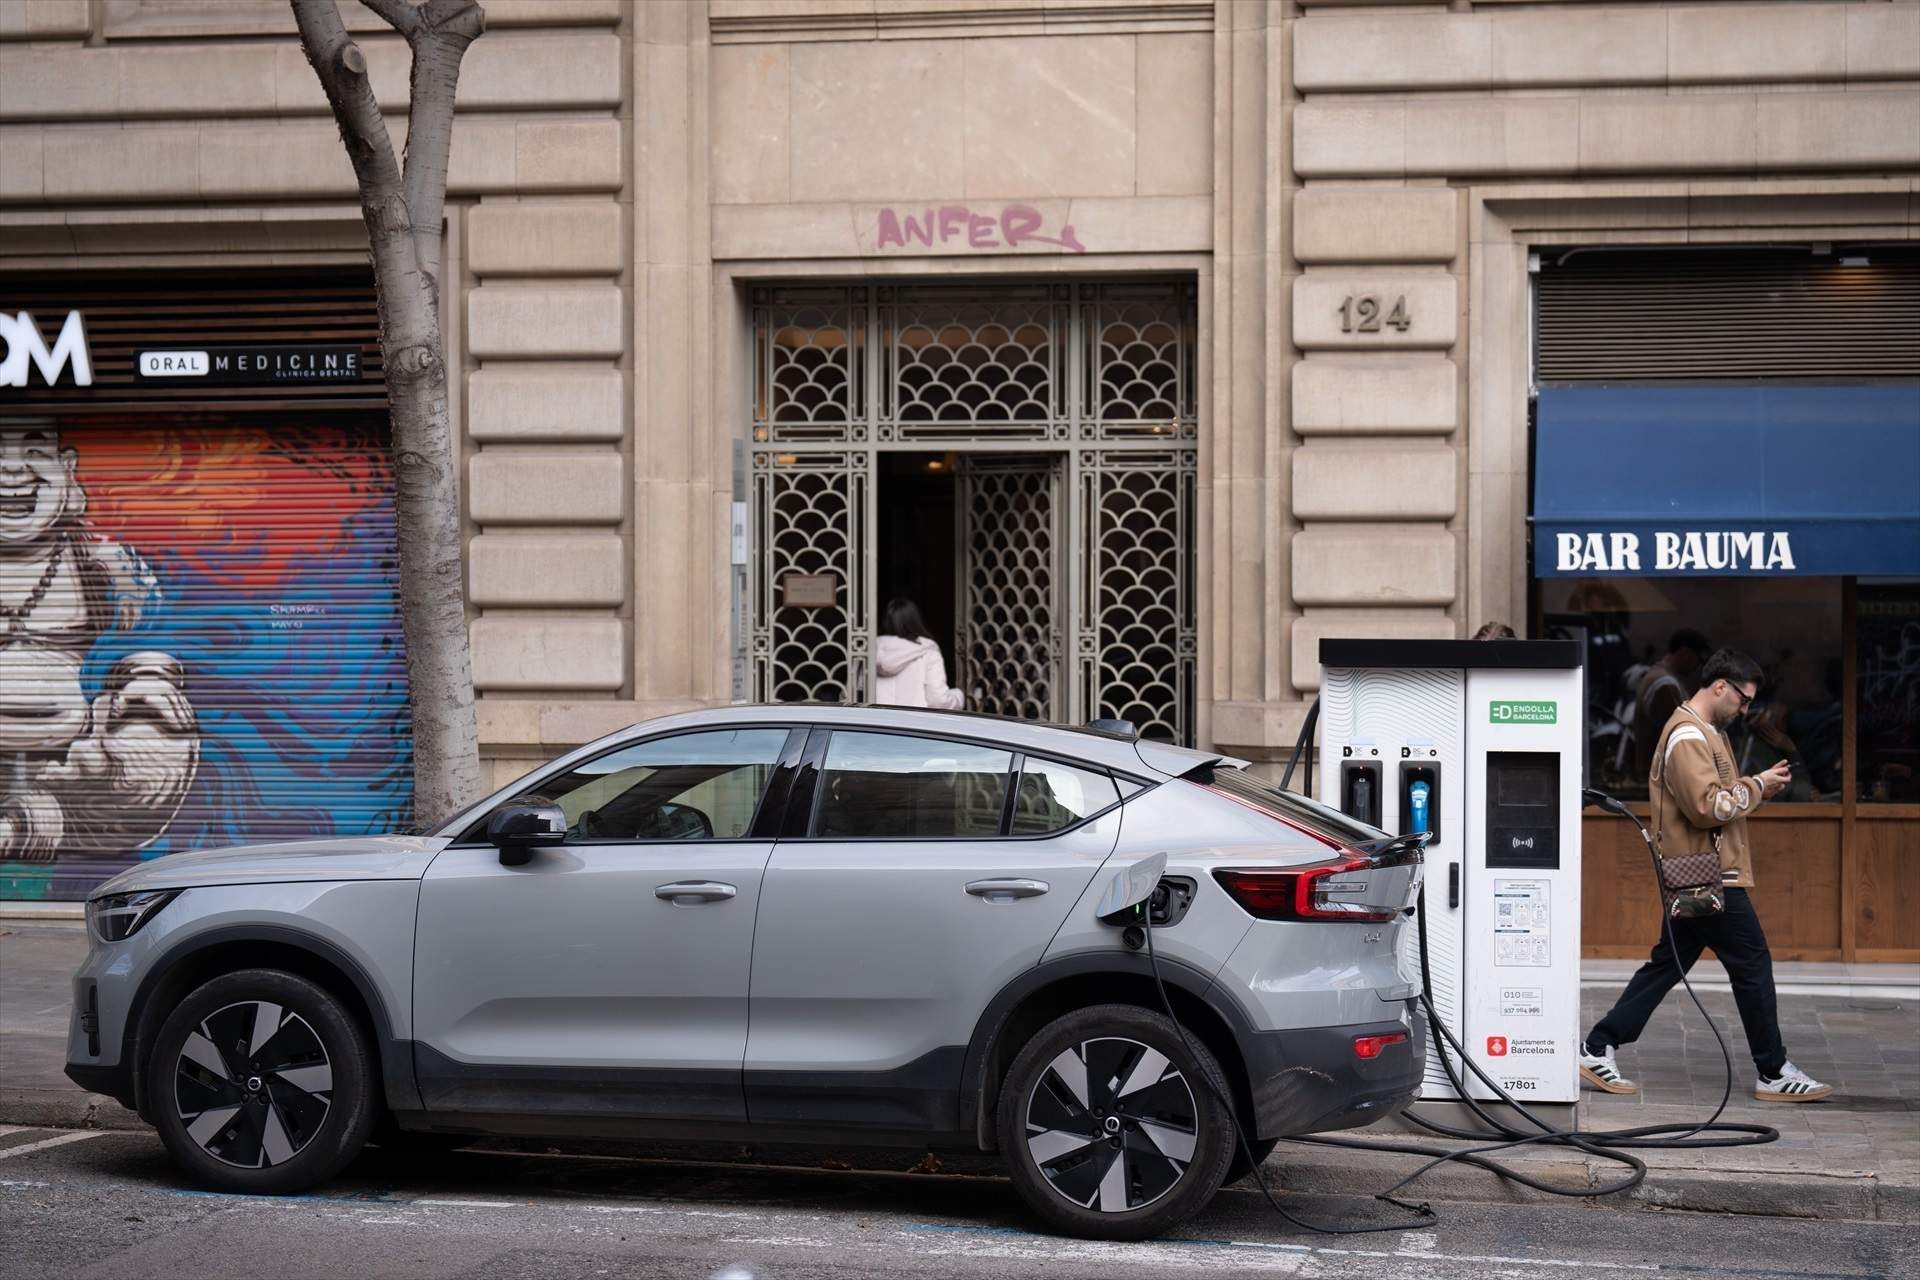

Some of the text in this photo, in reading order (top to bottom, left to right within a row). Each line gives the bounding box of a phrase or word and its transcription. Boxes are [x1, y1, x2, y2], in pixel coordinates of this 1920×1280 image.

[878, 204, 1086, 253] ANFER
[1338, 295, 1411, 333] 124
[150, 354, 357, 371] ORAL MEDICINE
[1556, 532, 1796, 571] BAR BAUMA
[1504, 991, 1521, 999] 010
[1511, 1046, 1555, 1054] Barcelona
[1504, 1080, 1537, 1090] 17801
